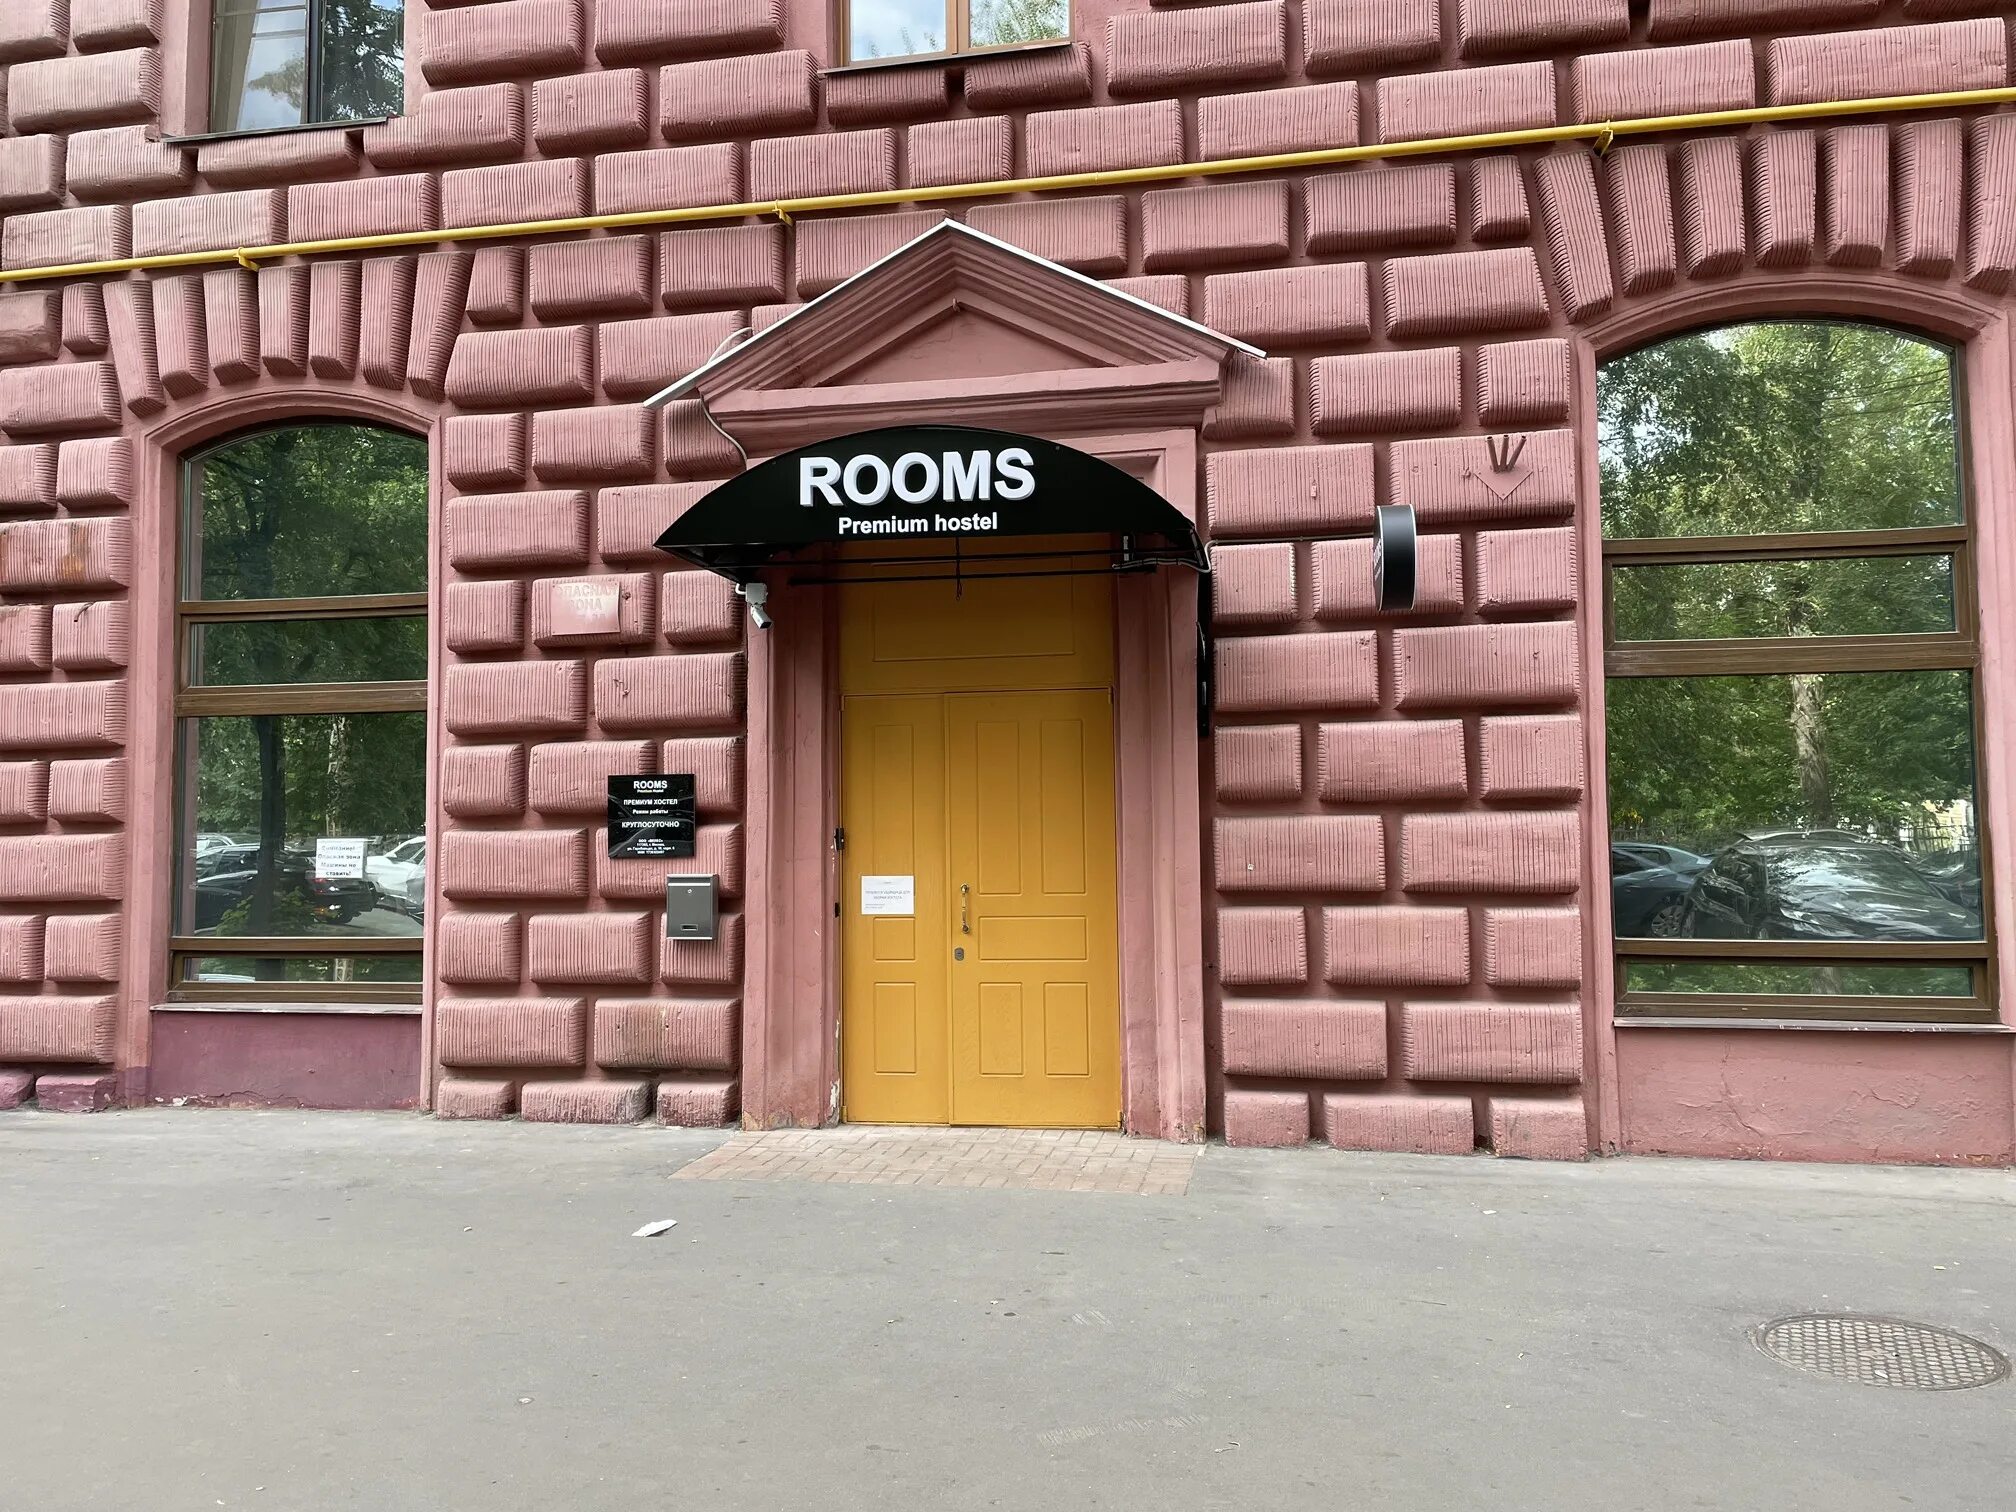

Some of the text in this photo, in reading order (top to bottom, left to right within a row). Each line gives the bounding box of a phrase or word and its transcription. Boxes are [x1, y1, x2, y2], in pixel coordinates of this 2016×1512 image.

[799, 447, 1036, 508] ROOMS
[838, 512, 998, 535] Premium hostel
[633, 780, 668, 789] ROOMS
